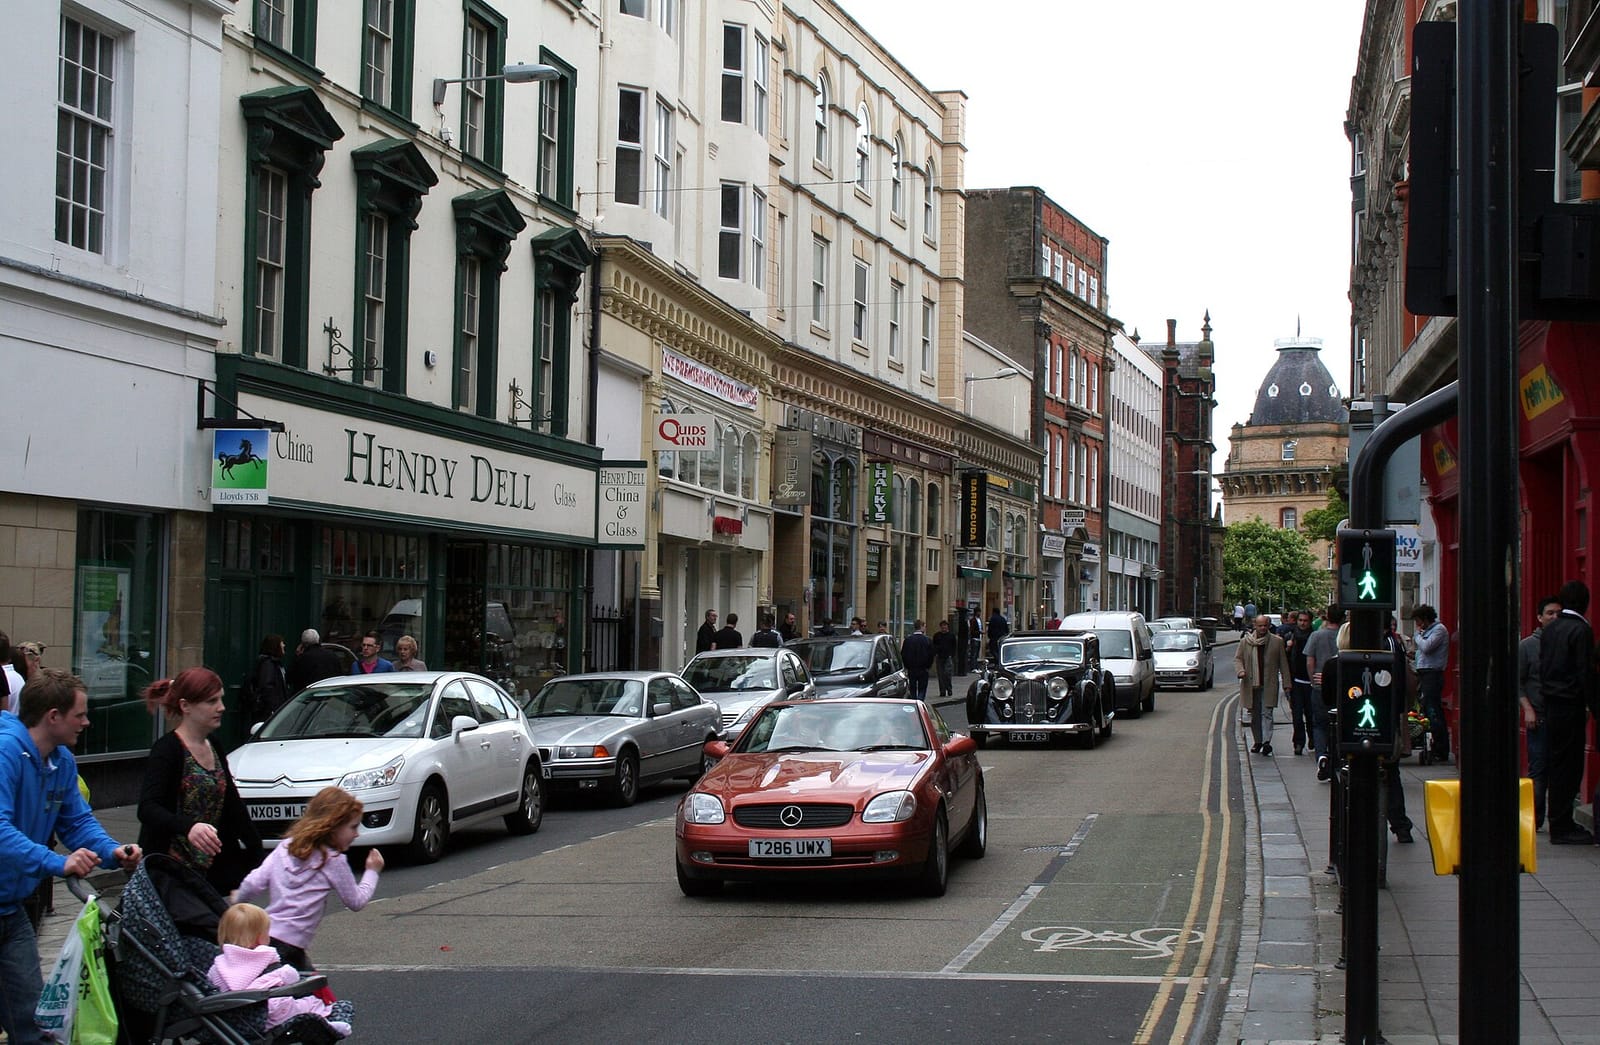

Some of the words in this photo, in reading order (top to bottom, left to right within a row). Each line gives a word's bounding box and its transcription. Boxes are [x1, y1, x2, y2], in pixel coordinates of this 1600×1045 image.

[658, 418, 707, 446] QUIDS
[275, 430, 314, 464] China
[681, 436, 706, 446] INN
[344, 428, 458, 499] HENRY
[470, 454, 536, 511] DELL
[600, 470, 626, 485] HENRY
[627, 470, 645, 485] DELL
[220, 492, 244, 502] Lloyds
[245, 493, 259, 501] TSB
[554, 483, 577, 508] Glass
[605, 487, 640, 502] China
[616, 505, 629, 520] &
[970, 478, 978, 542] BARRACUDA
[605, 521, 638, 537] Glass
[251, 806, 281, 818] NX09
[755, 841, 792, 855] T286
[796, 841, 825, 855] UWX
